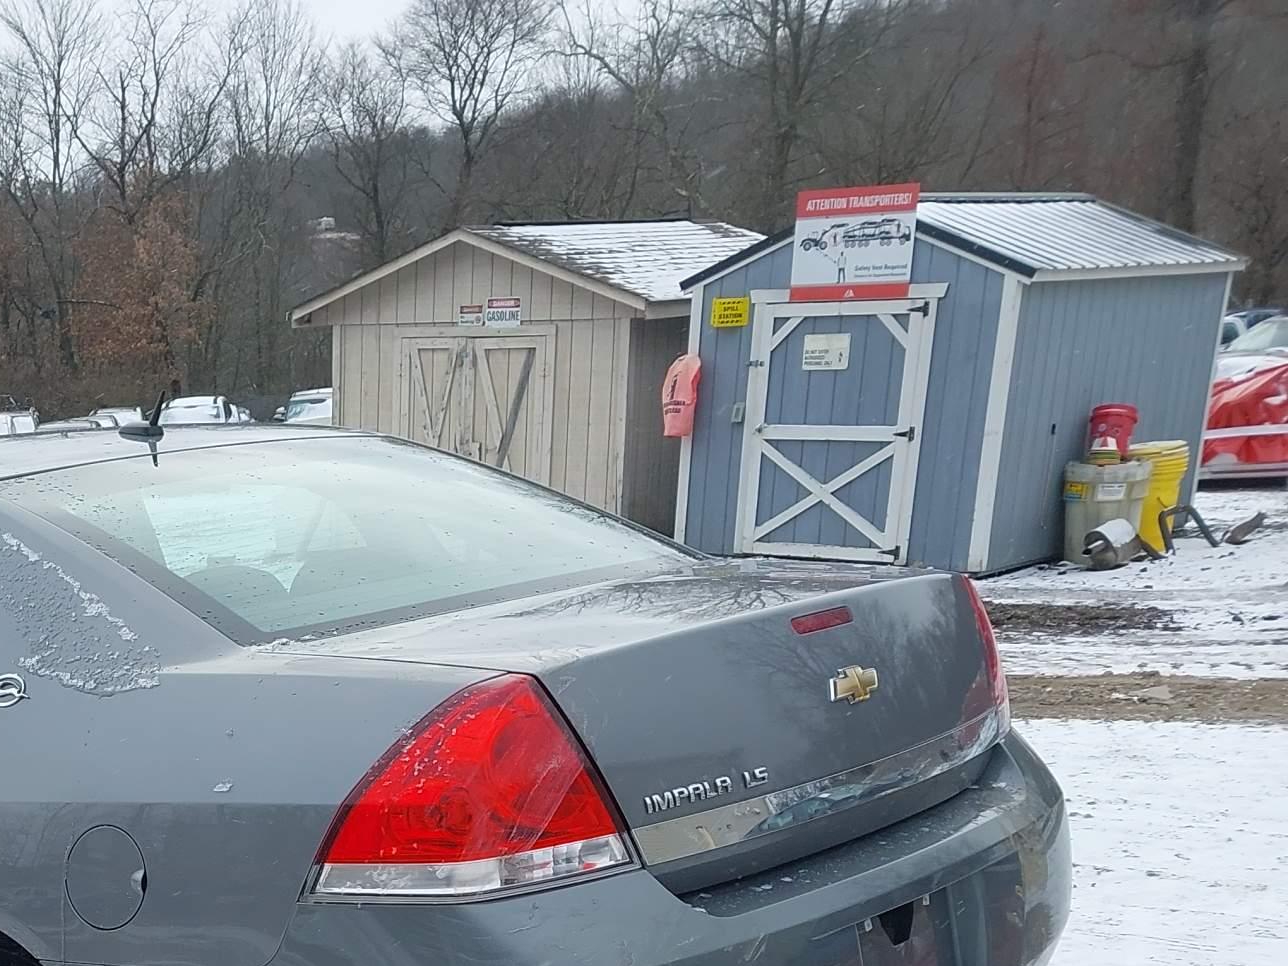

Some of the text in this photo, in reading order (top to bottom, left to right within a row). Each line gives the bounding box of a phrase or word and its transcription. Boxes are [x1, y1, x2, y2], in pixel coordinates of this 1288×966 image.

[806, 193, 913, 211] ATTENTION TRANSPORTERS!
[487, 310, 520, 321] GASOLINE
[644, 766, 769, 814] IMPALA LS
